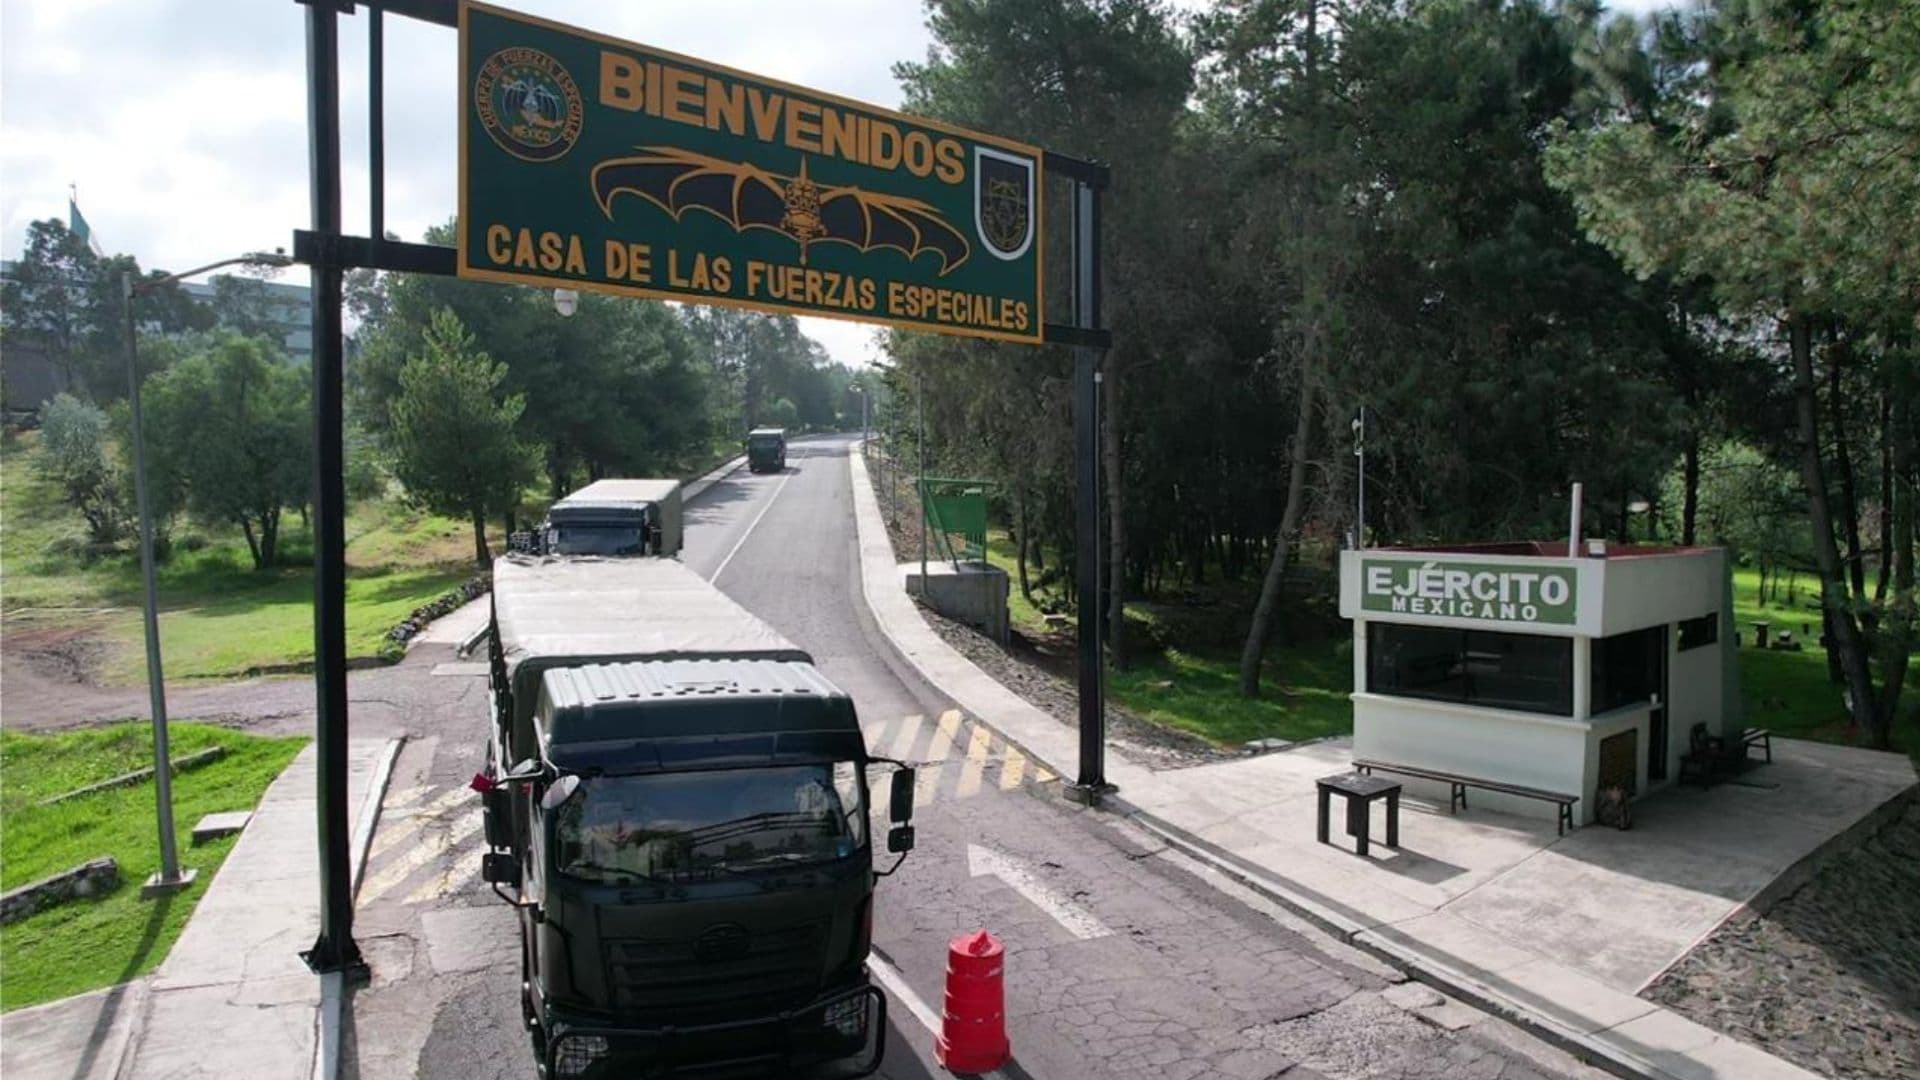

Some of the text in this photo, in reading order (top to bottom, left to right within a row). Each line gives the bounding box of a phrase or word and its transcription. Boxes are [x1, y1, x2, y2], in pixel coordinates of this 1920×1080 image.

[600, 51, 965, 185] BIENVENIDOS
[487, 224, 1028, 331] CASA DE LAS FUERZAS ESPECIALES
[1367, 562, 1569, 606] EJÉRCITO
[1392, 596, 1537, 622] MEXICANO
